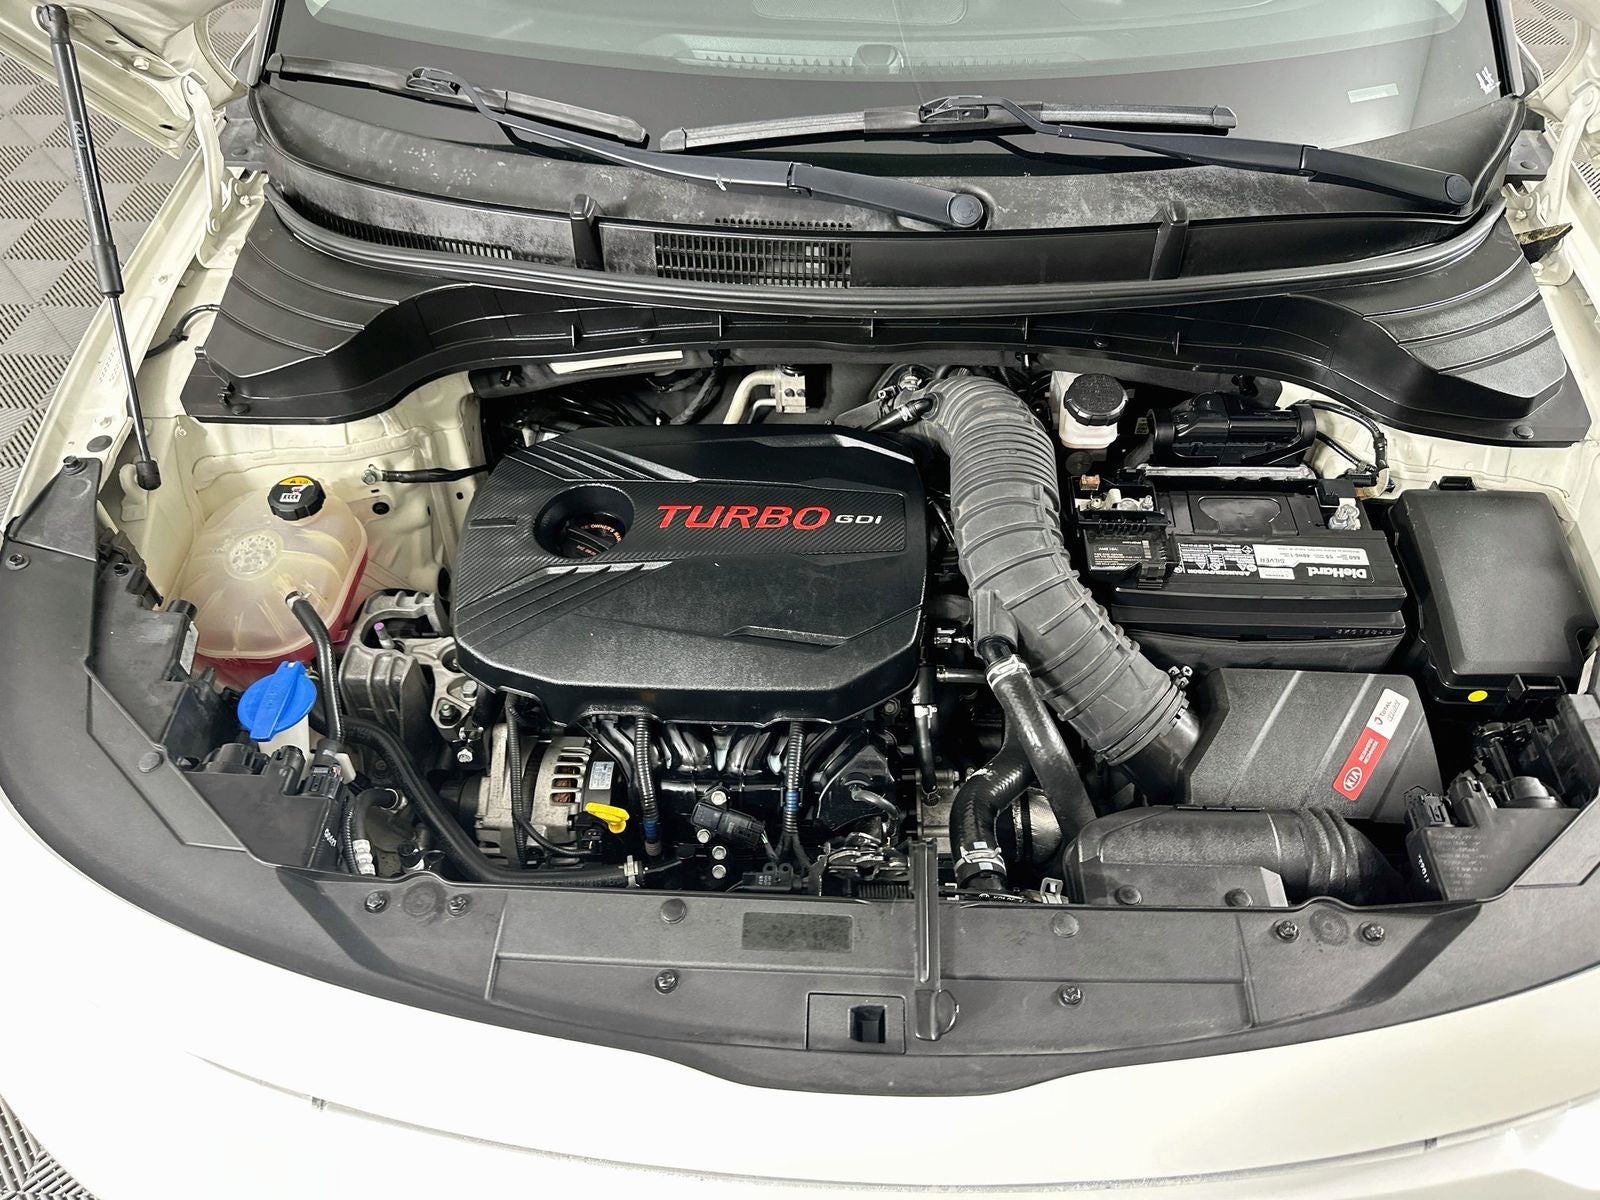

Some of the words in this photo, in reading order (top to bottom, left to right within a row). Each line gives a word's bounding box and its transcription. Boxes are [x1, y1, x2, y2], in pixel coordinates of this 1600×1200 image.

[657, 505, 831, 530] TURBO
[834, 514, 883, 525] GDI
[1306, 566, 1367, 579] DieHard
[1344, 768, 1362, 789] KIA
